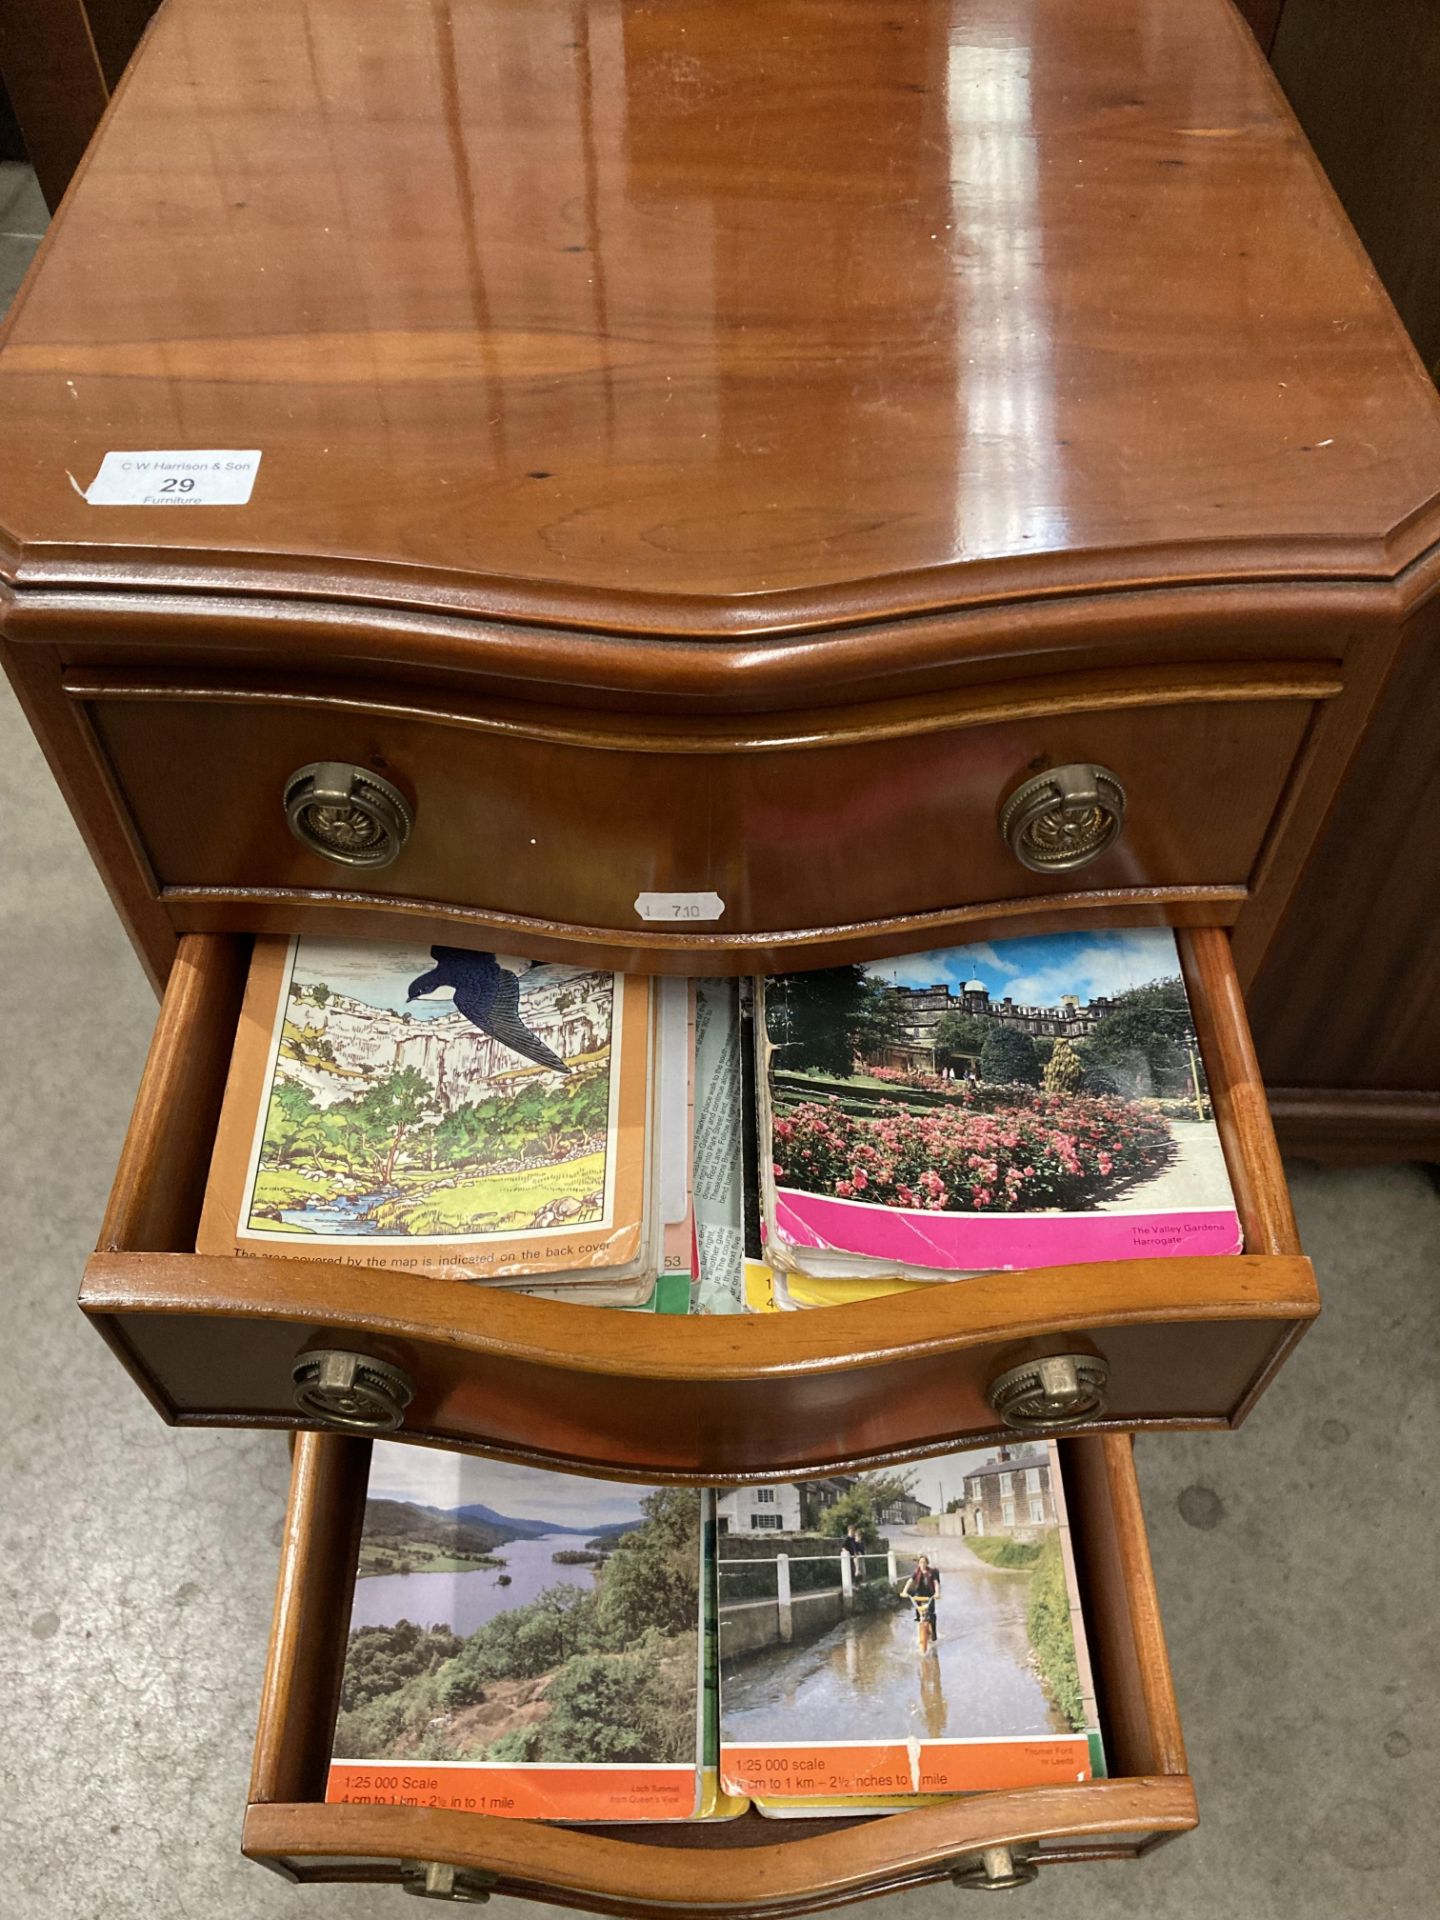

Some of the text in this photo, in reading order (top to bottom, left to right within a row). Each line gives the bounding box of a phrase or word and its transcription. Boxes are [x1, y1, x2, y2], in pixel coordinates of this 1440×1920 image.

[154, 463, 208, 471] Harrison
[212, 463, 221, 471] &
[225, 463, 251, 471] Son
[160, 478, 195, 493] 29
[143, 496, 202, 504] Furniture
[1132, 1226, 1150, 1234] The
[1184, 1224, 1225, 1232] Gardens
[1133, 1238, 1182, 1246] Harrogate
[367, 1256, 387, 1267] the
[391, 1258, 418, 1268] map
[422, 1256, 432, 1265] is
[438, 1253, 495, 1266] indicated
[500, 1252, 516, 1262] on
[521, 1250, 541, 1260] the
[545, 1245, 574, 1257] back
[578, 1242, 611, 1253] cover
[664, 1256, 681, 1267] 53
[765, 1759, 788, 1770] 000
[792, 1758, 824, 1770] scale
[345, 1777, 439, 1789] 1:25 000 Scale
[770, 1778, 781, 1788] to
[785, 1778, 791, 1788] 1
[796, 1777, 814, 1788] km
[896, 1774, 908, 1785] to
[922, 1773, 948, 1784] mile
[450, 1796, 462, 1807] in
[465, 1797, 476, 1808] to
[490, 1798, 515, 1808] mile
